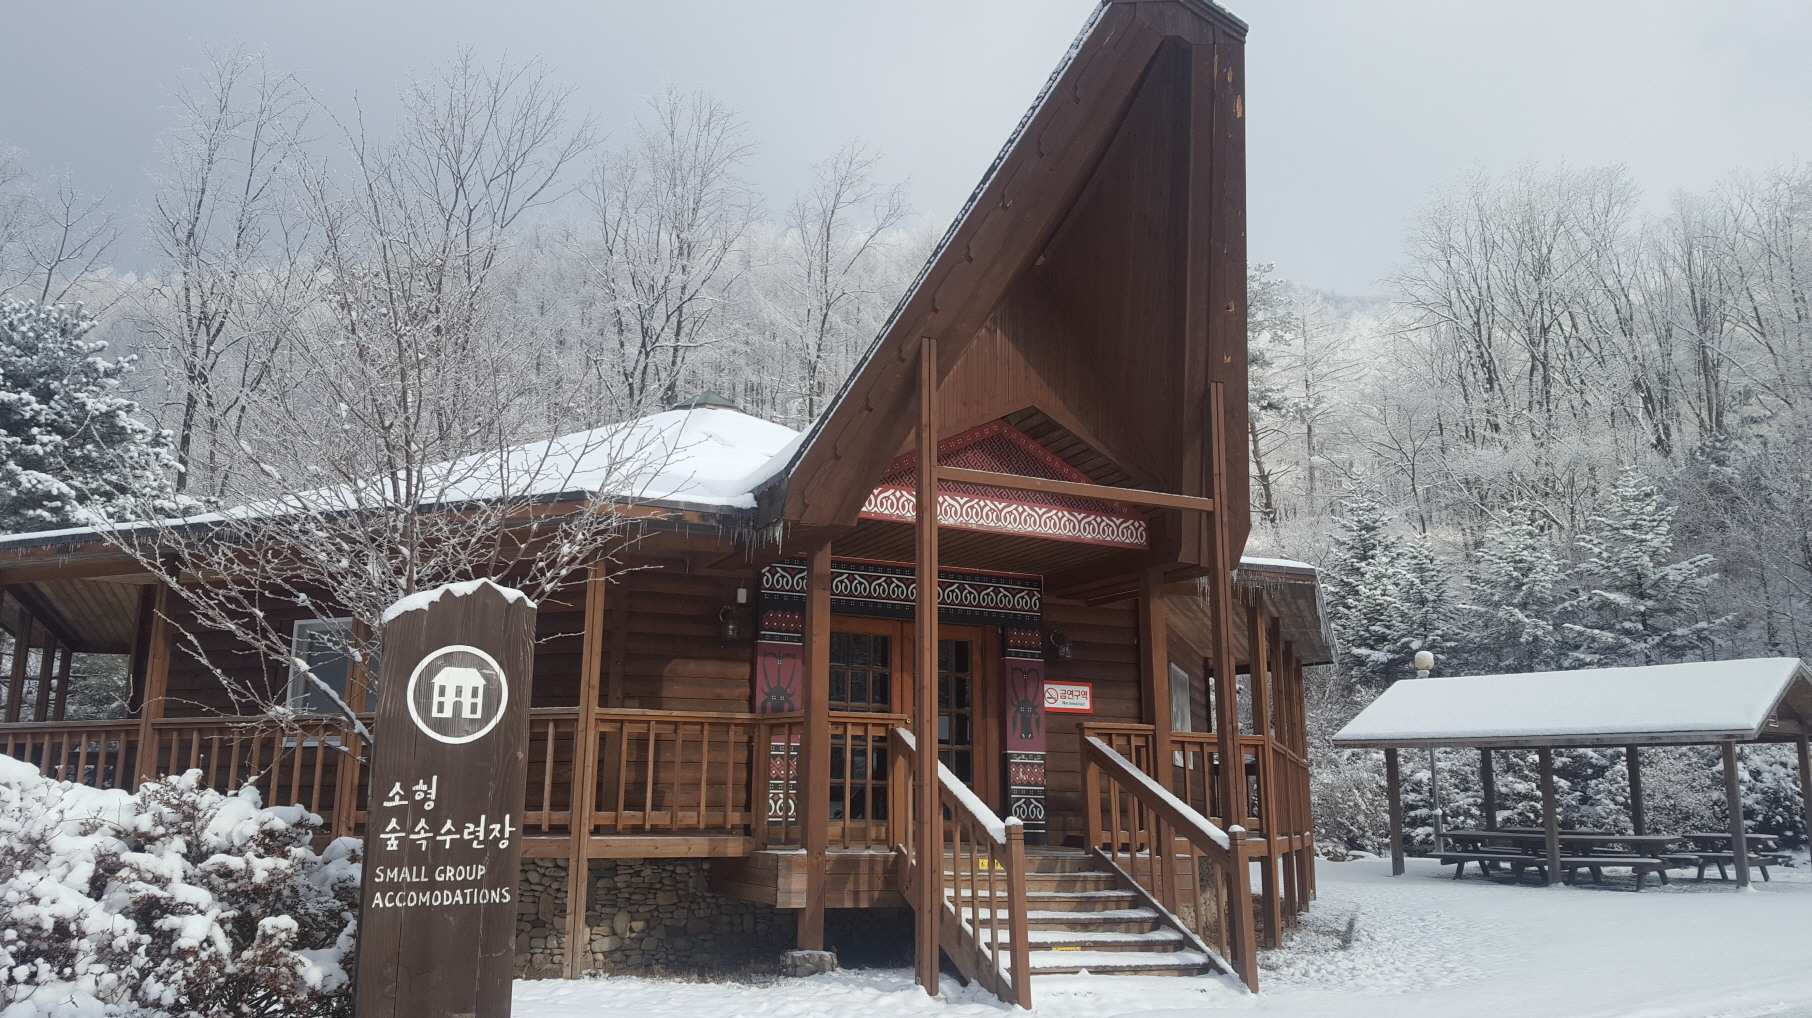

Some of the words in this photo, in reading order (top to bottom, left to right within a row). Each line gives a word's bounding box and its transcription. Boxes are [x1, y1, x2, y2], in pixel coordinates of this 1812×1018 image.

[1060, 689, 1088, 701] 금연구역
[383, 775, 438, 810] 소형
[379, 814, 516, 851] 숲속수련장
[374, 866, 429, 882] SMALL
[435, 864, 487, 882] GROUP
[371, 887, 511, 908] ACCOMODATIONS
